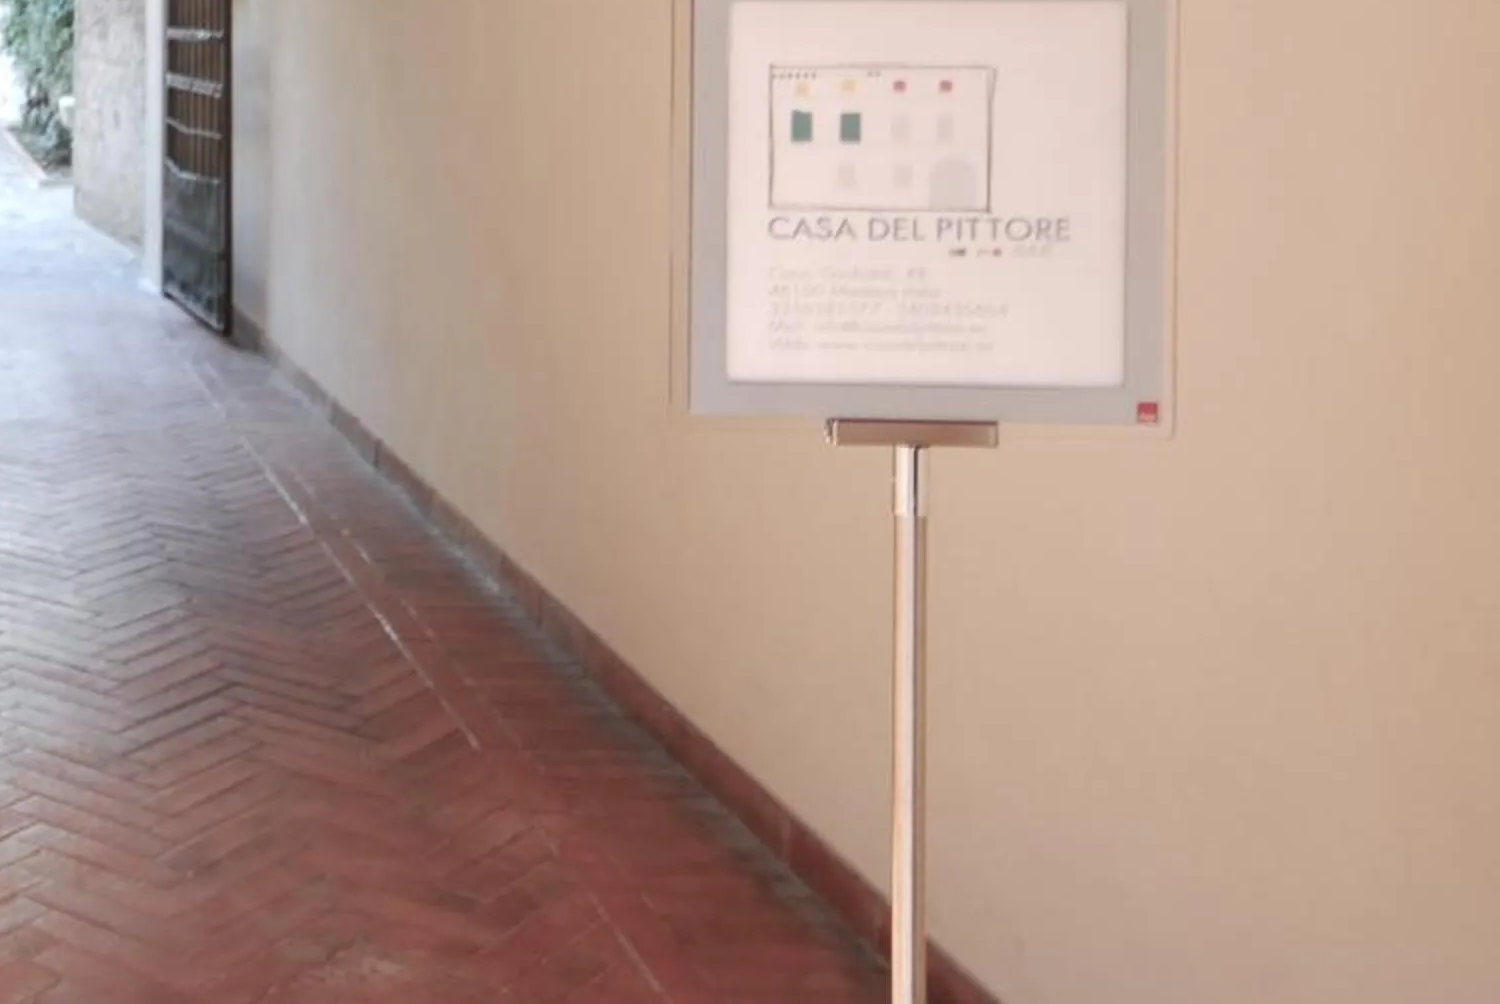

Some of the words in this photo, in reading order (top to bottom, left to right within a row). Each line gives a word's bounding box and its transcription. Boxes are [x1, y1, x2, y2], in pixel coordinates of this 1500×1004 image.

[768, 216, 856, 242] CASA
[868, 217, 926, 242] DEL
[936, 217, 1071, 242] PITTORE
